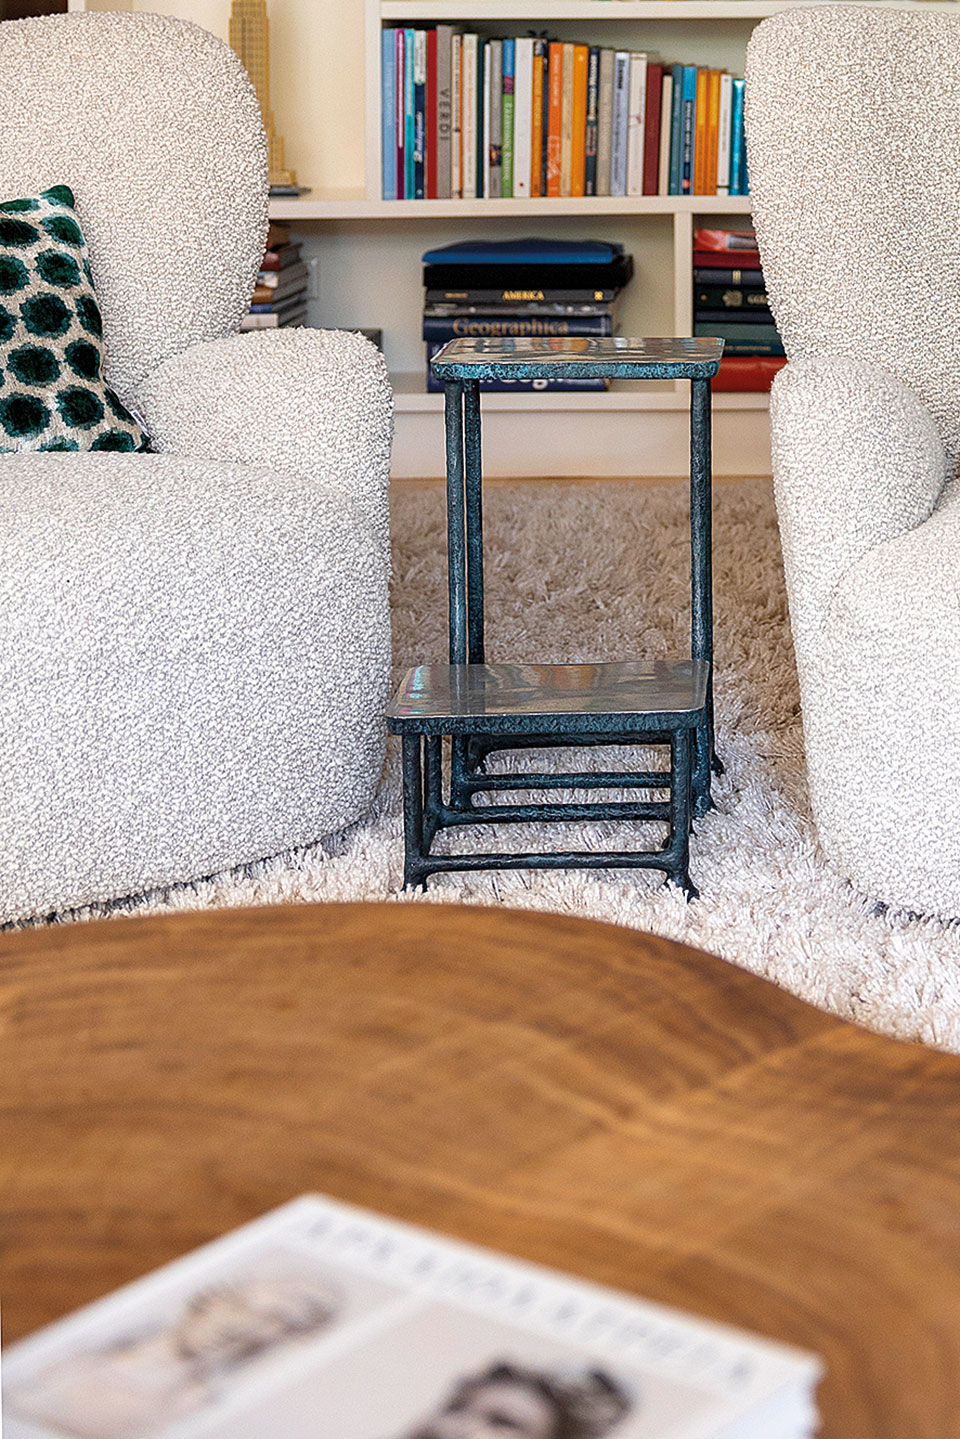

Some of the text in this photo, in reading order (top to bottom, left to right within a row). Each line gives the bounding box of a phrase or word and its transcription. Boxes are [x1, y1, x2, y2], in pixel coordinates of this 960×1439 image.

[439, 88, 449, 142] VERDI
[502, 291, 544, 301] AMERICA
[452, 318, 569, 337] Geographica
